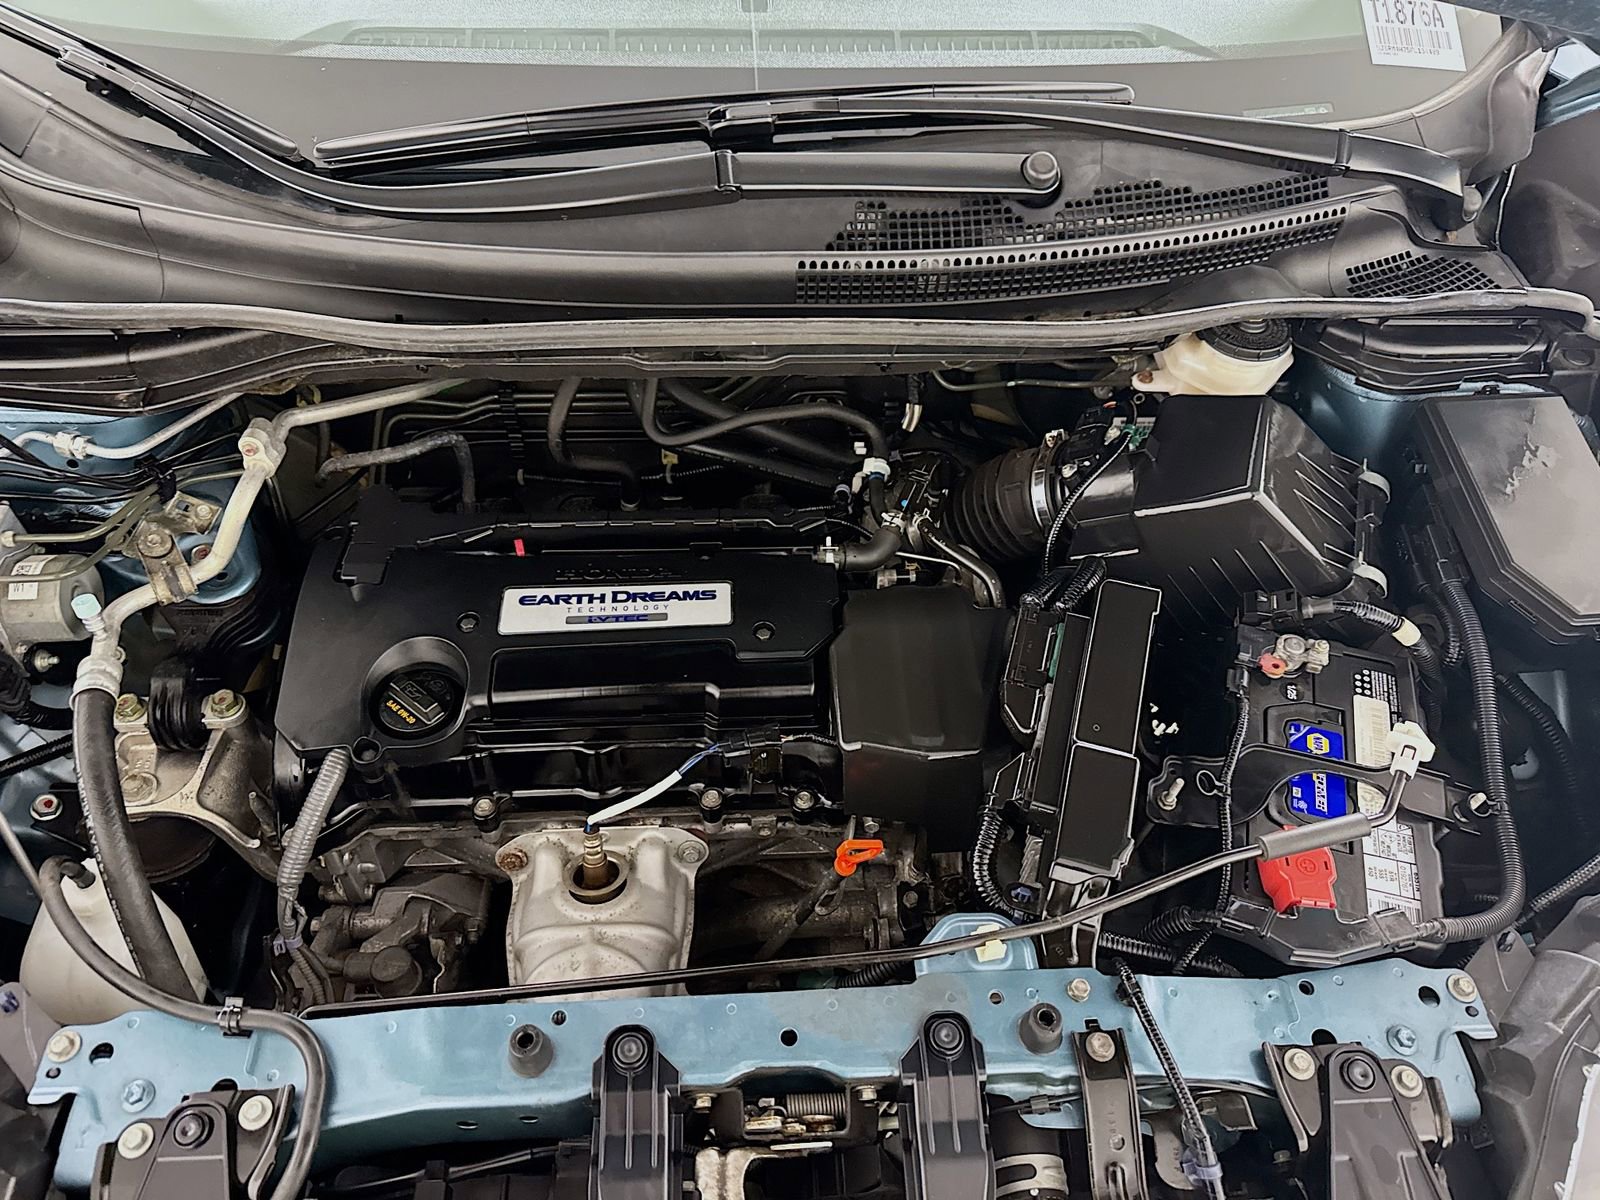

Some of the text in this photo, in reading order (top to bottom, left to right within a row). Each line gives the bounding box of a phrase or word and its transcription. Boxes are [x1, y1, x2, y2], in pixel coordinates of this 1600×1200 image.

[518, 589, 717, 606] EARTH DREAMS
[566, 605, 669, 613] TECHNOLOGY
[386, 700, 401, 712] SAE
[1313, 735, 1324, 752] NAPA
